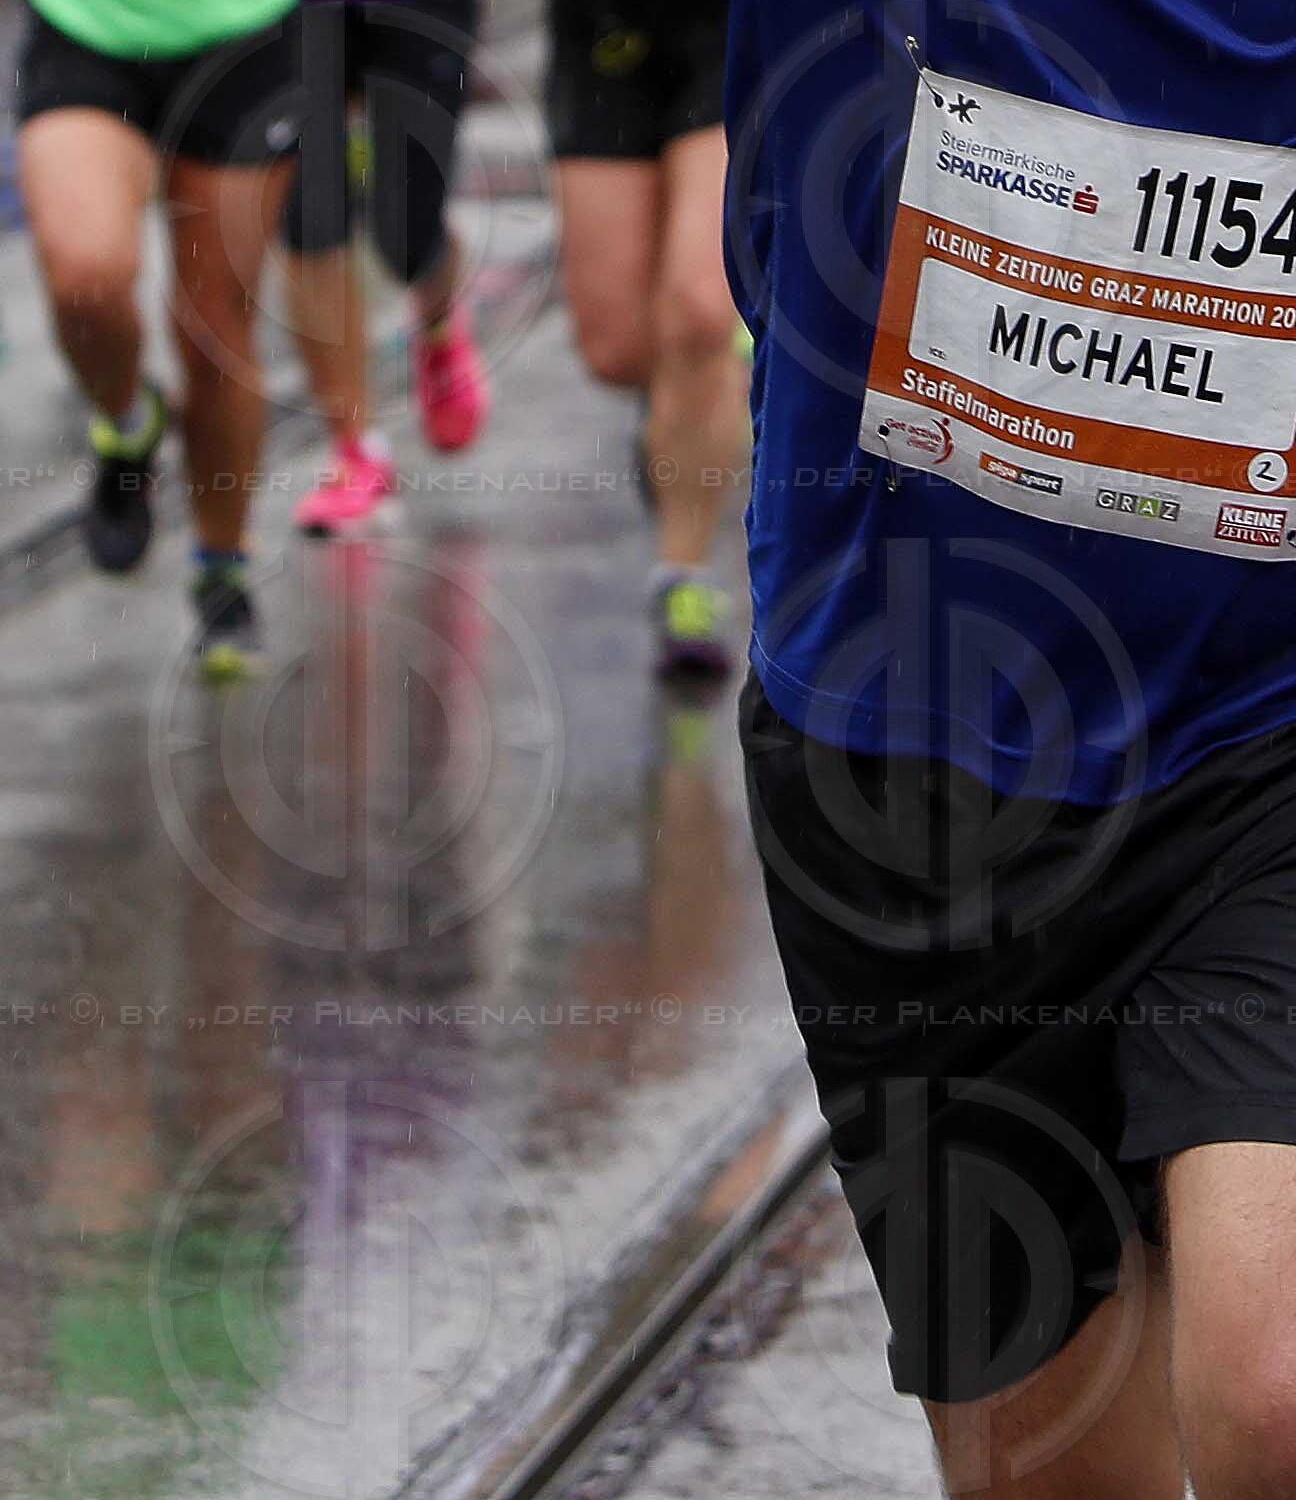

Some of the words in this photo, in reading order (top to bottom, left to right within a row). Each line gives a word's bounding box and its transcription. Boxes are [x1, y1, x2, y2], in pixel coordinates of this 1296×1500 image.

[940, 129, 1076, 183] Steiermärkische
[936, 150, 1073, 208] SPARKASSE
[925, 225, 993, 268] KLEINE
[995, 252, 1084, 293] ZEITUNG
[1090, 277, 1147, 307] GRAZ
[1152, 288, 1266, 327] MARATHON
[988, 302, 1225, 404] MICHAEL
[901, 367, 1076, 450] Staffelmarathon
[1020, 471, 1060, 492] sport
[1255, 460, 1277, 482] 2
[1097, 490, 1179, 521] GRAZ
[1221, 506, 1284, 529] KLEINE
[1217, 525, 1280, 545] ZEITUNG
